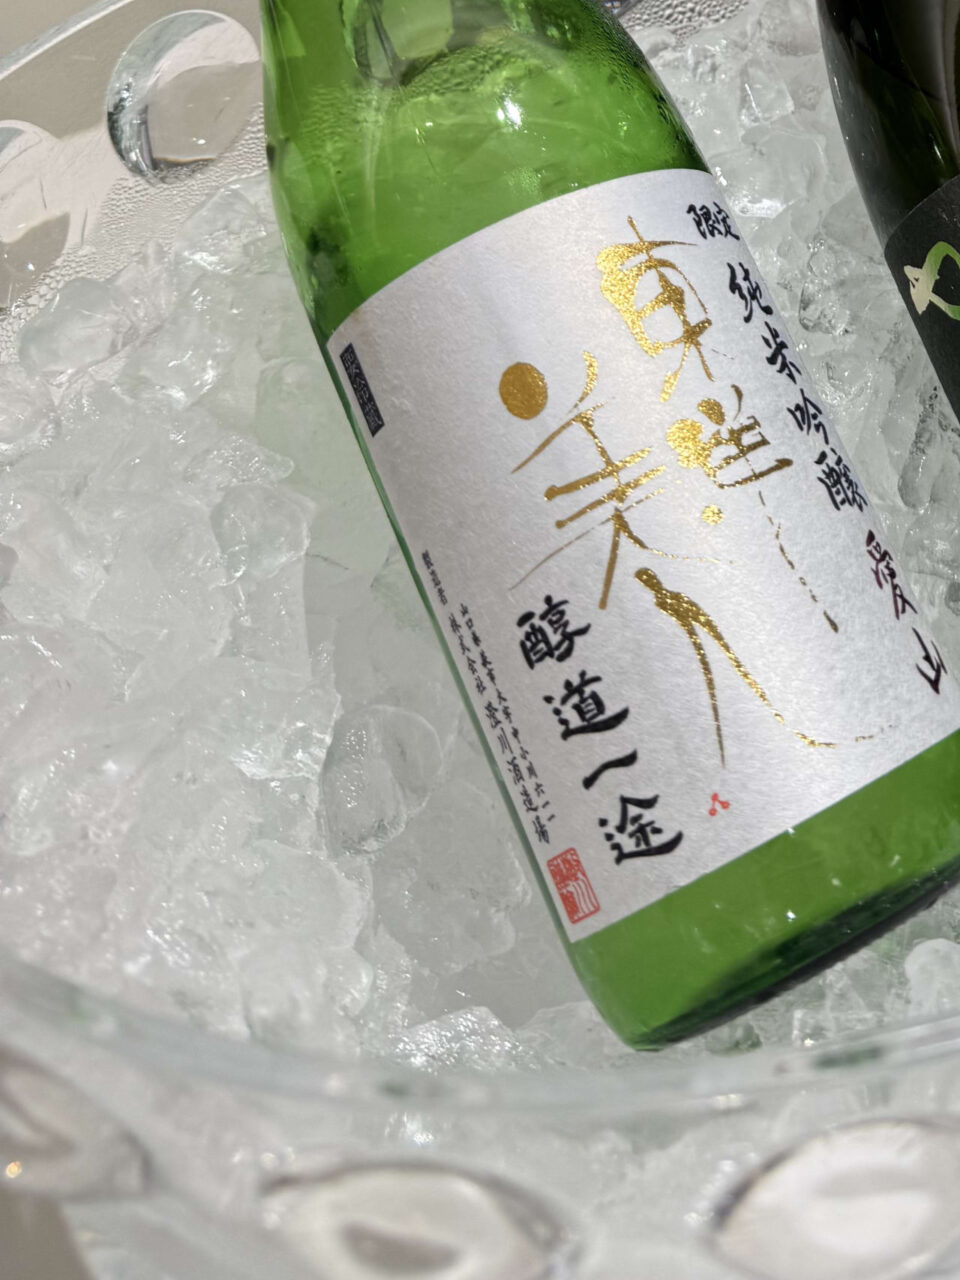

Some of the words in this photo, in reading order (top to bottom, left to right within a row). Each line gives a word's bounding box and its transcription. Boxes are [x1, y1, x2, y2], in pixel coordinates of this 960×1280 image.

[687, 203, 741, 241] 限定
[517, 593, 684, 866] 醇道一途
